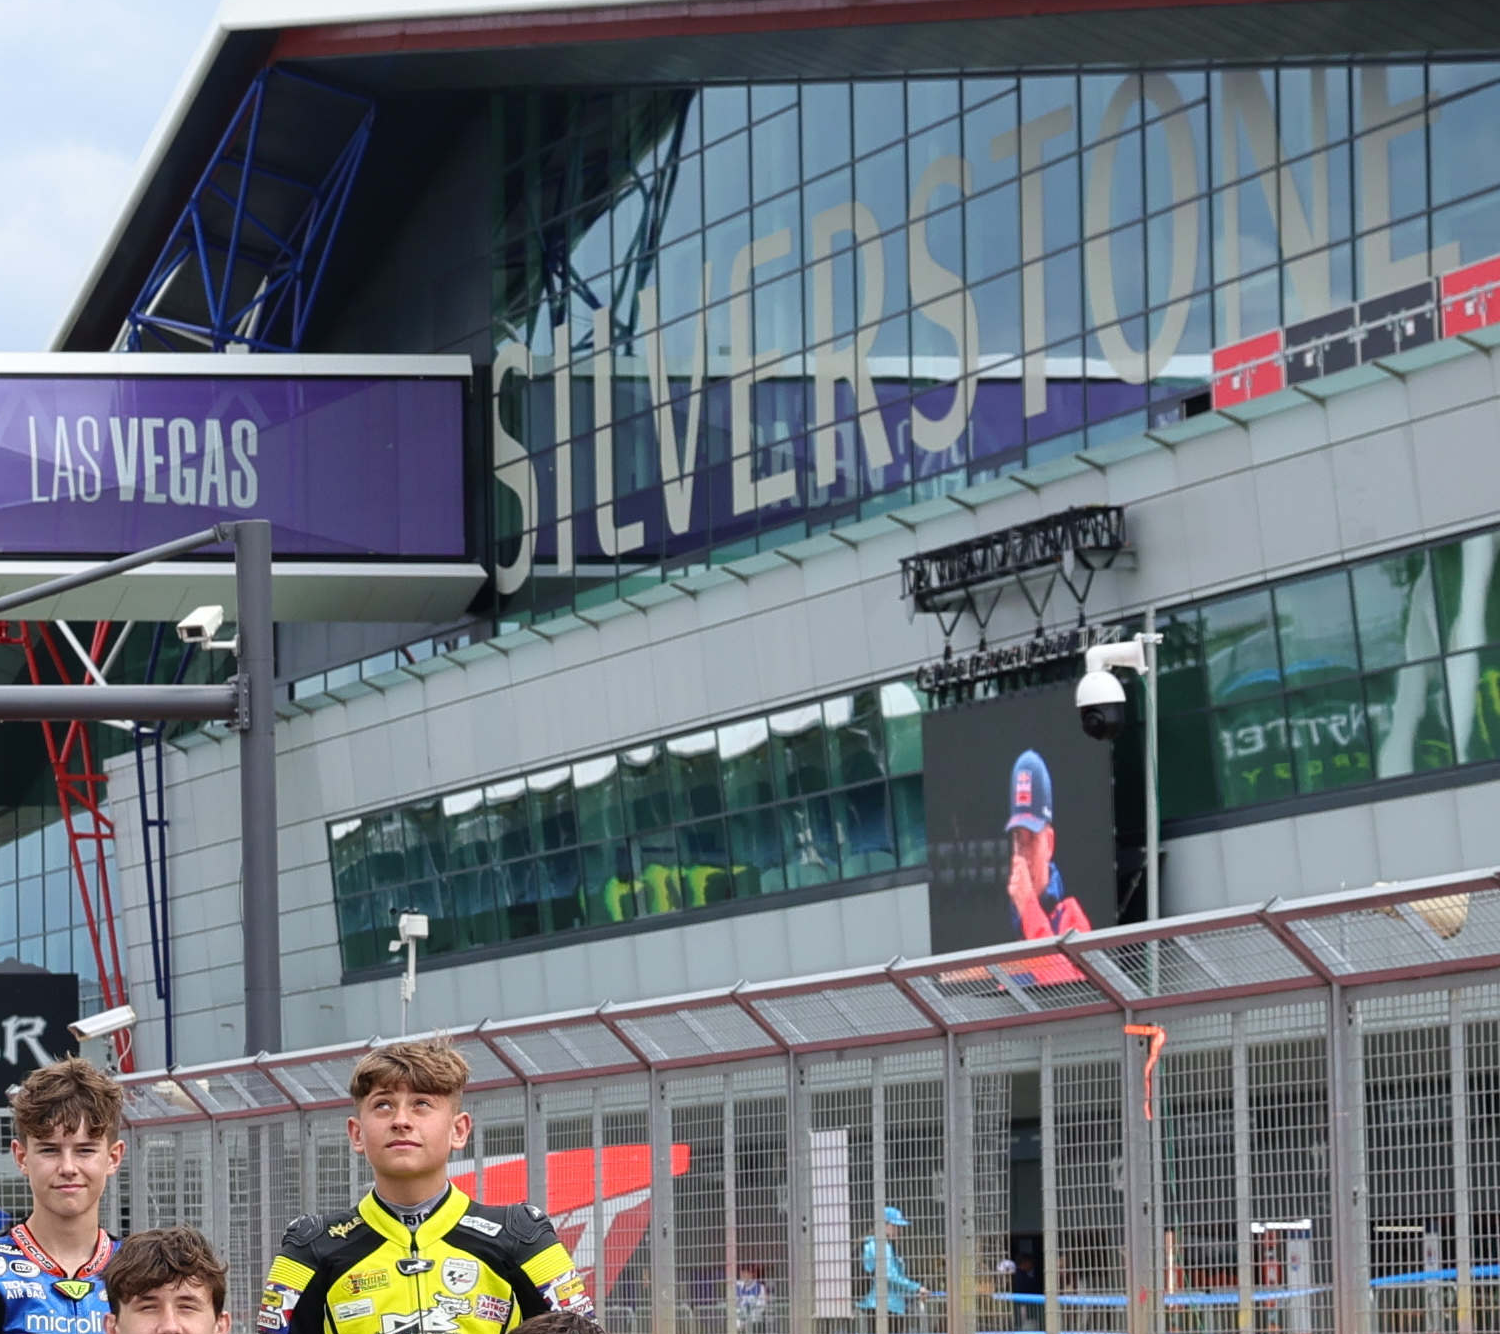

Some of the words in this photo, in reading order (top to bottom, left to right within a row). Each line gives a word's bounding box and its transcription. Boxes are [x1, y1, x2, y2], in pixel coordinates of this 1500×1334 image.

[32, 416, 102, 503] LAS
[113, 416, 258, 509] VEGAS
[492, 70, 1463, 596] SILVERSTONE
